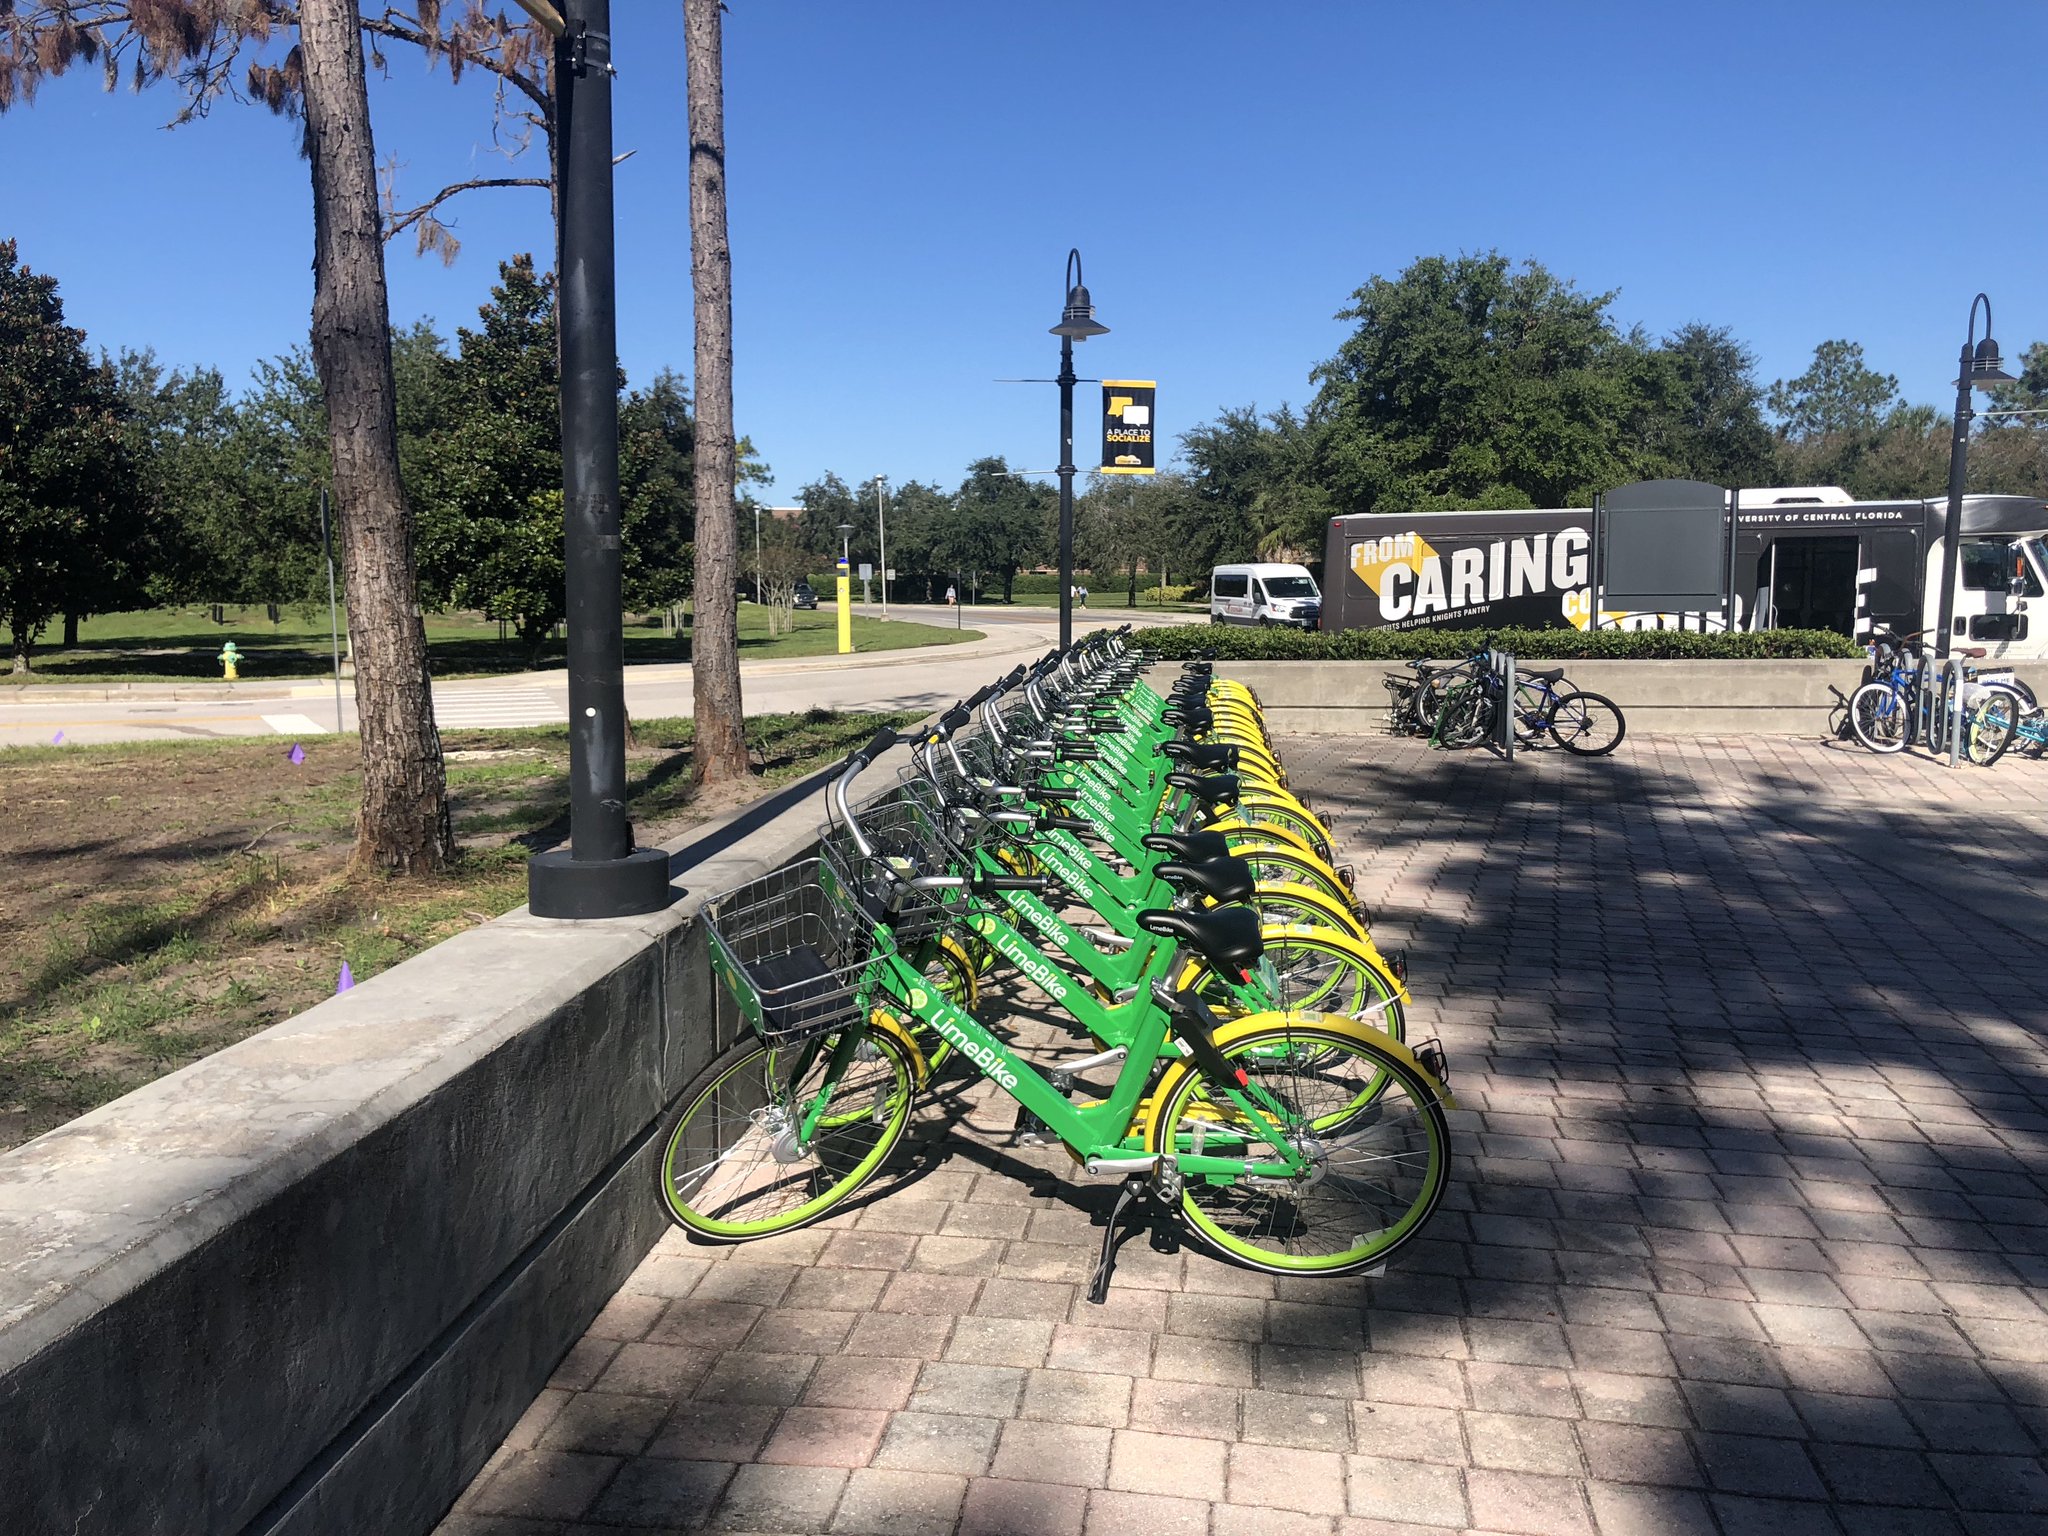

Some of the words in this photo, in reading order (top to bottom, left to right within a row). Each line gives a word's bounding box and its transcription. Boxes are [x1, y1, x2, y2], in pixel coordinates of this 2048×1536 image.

[1723, 514, 1780, 523] VERSITY
[1784, 514, 1799, 522] OF
[1802, 513, 1851, 521] CENTRAL
[1855, 511, 1903, 520] FLORIDA
[1350, 531, 1416, 569] FROM
[1379, 526, 1591, 621] CARING
[1401, 616, 1431, 629] HELPING
[1432, 610, 1462, 623] KNIGHTS
[1463, 605, 1491, 617] PANTRY
[1074, 765, 1111, 801] LimeBike
[1086, 759, 1119, 787] imeBike
[1045, 827, 1093, 869] imeBike
[1039, 846, 1094, 899] LimeBike
[1007, 889, 1070, 946] LimeBike
[1149, 924, 1174, 934] LimeBike
[997, 933, 1067, 999] LimeBike
[930, 1008, 1018, 1090] LimeBike
